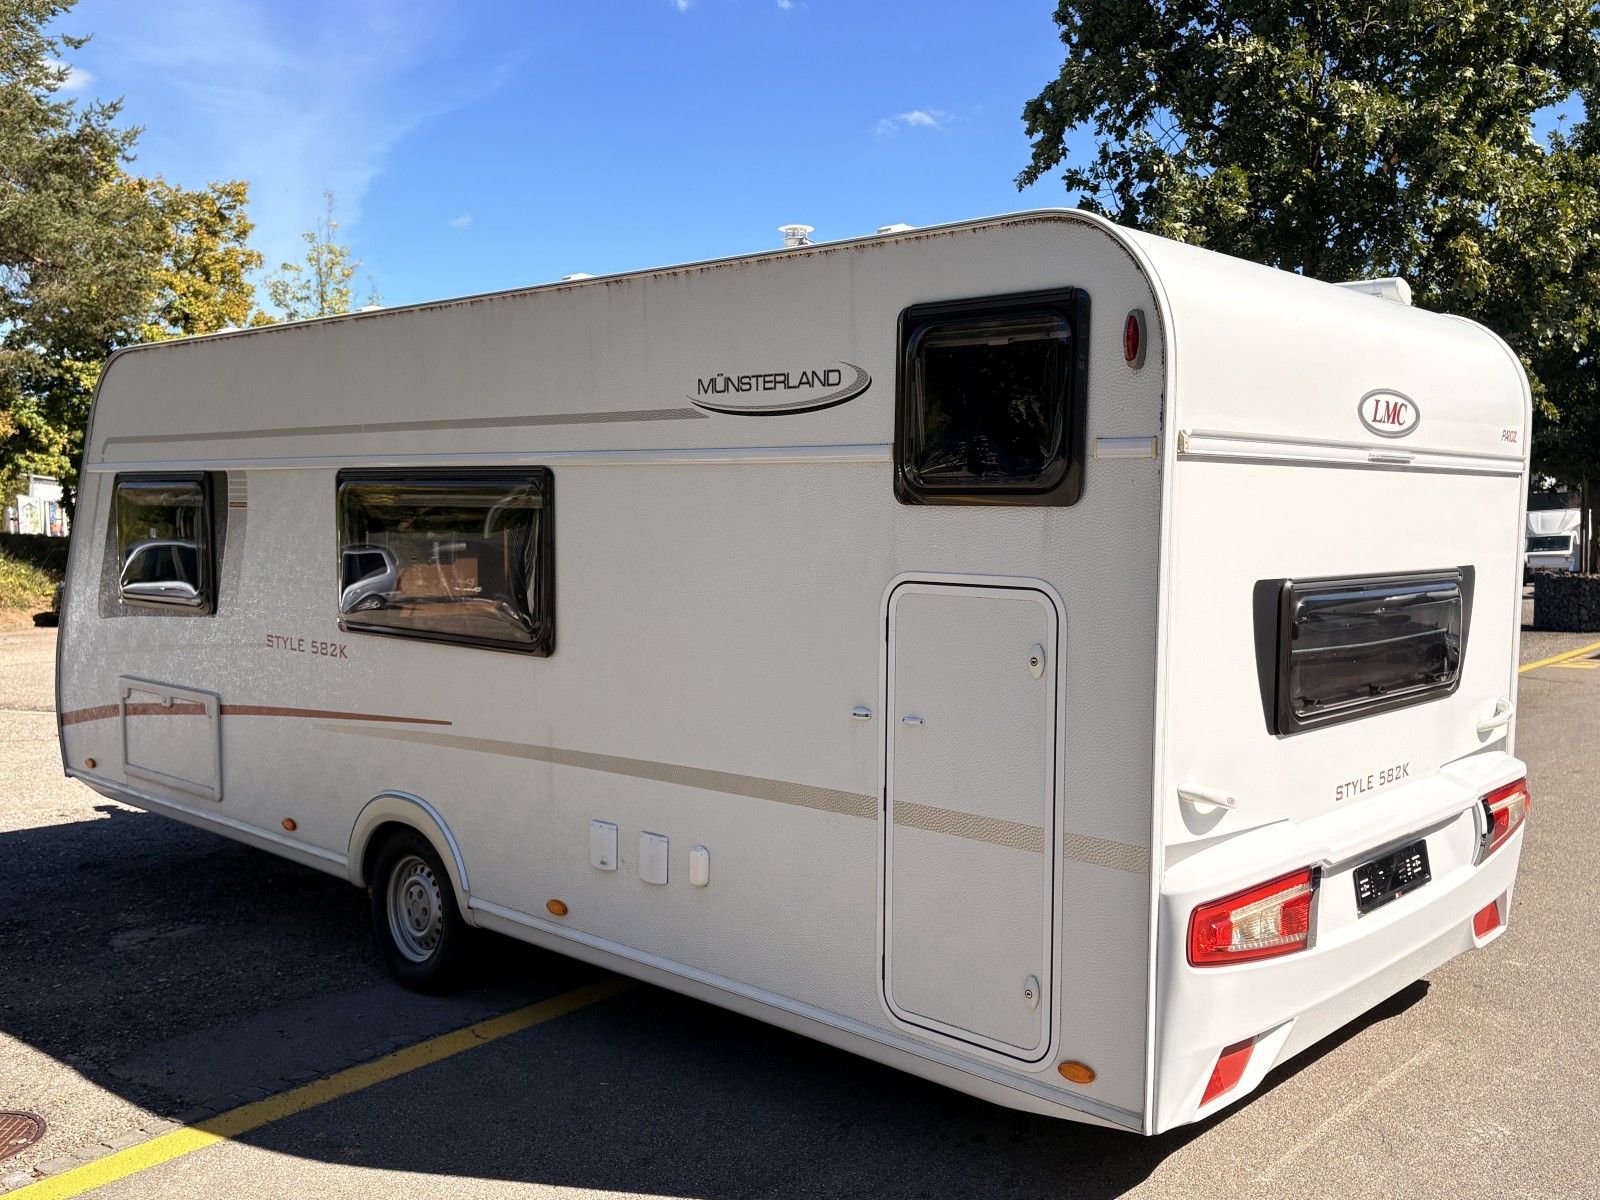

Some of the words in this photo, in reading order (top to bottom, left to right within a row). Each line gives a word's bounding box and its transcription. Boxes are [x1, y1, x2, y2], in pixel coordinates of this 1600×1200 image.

[697, 368, 841, 395] MÜNSTERLAND
[1371, 398, 1408, 427] LMC
[266, 634, 305, 652] STYLE
[311, 640, 348, 659] 582K
[1335, 774, 1374, 801] STYLE
[1379, 761, 1410, 786] 582K
